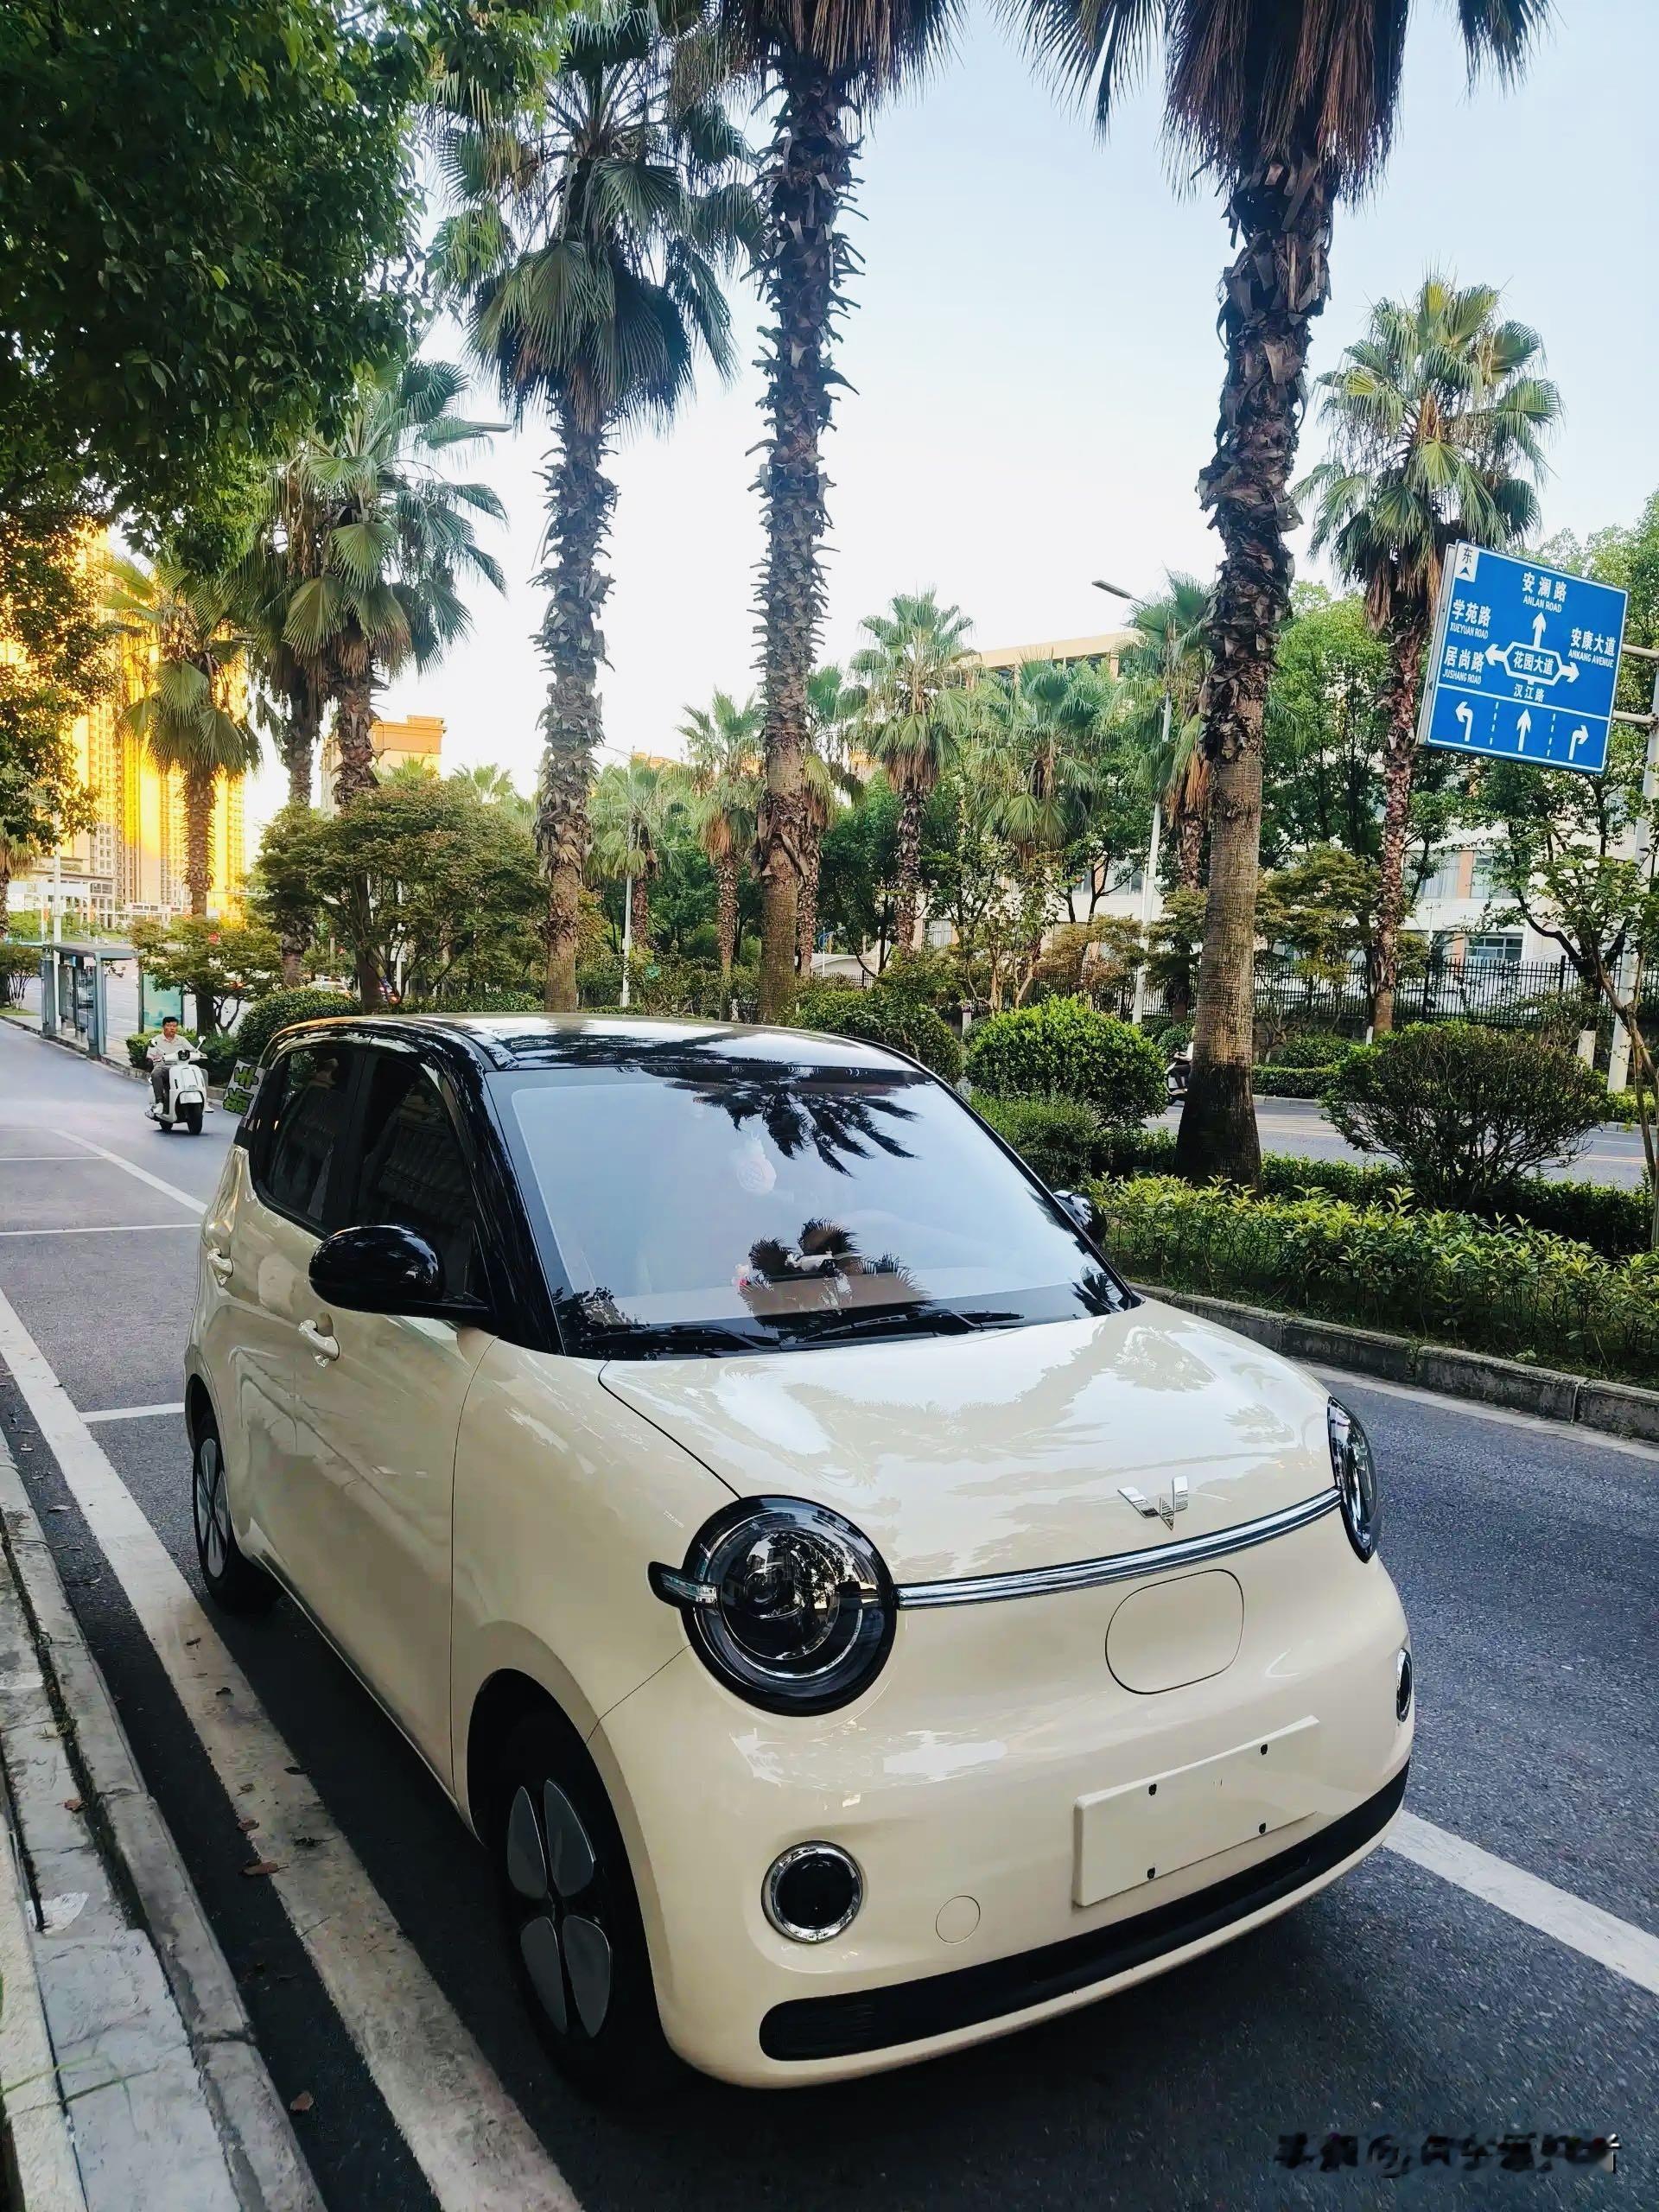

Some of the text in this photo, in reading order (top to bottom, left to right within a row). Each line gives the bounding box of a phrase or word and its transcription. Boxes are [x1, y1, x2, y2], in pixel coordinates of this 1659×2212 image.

[1462, 547, 1471, 563] 东
[1522, 571, 1567, 602] 安澜路
[1452, 599, 1491, 626] 学苑路
[1523, 597, 1562, 613] ANLAN ROAD
[1450, 622, 1489, 639] XUEYUAN ROAD
[1571, 628, 1616, 656] 安康大道
[1444, 646, 1484, 672] 居尚路
[1513, 651, 1554, 676] 花园大道
[1568, 650, 1613, 668] ANKANG AVENUE
[1467, 675, 1481, 684] ROAD
[1514, 684, 1544, 702] 汉江路
[223, 1066, 258, 1116] 新手
